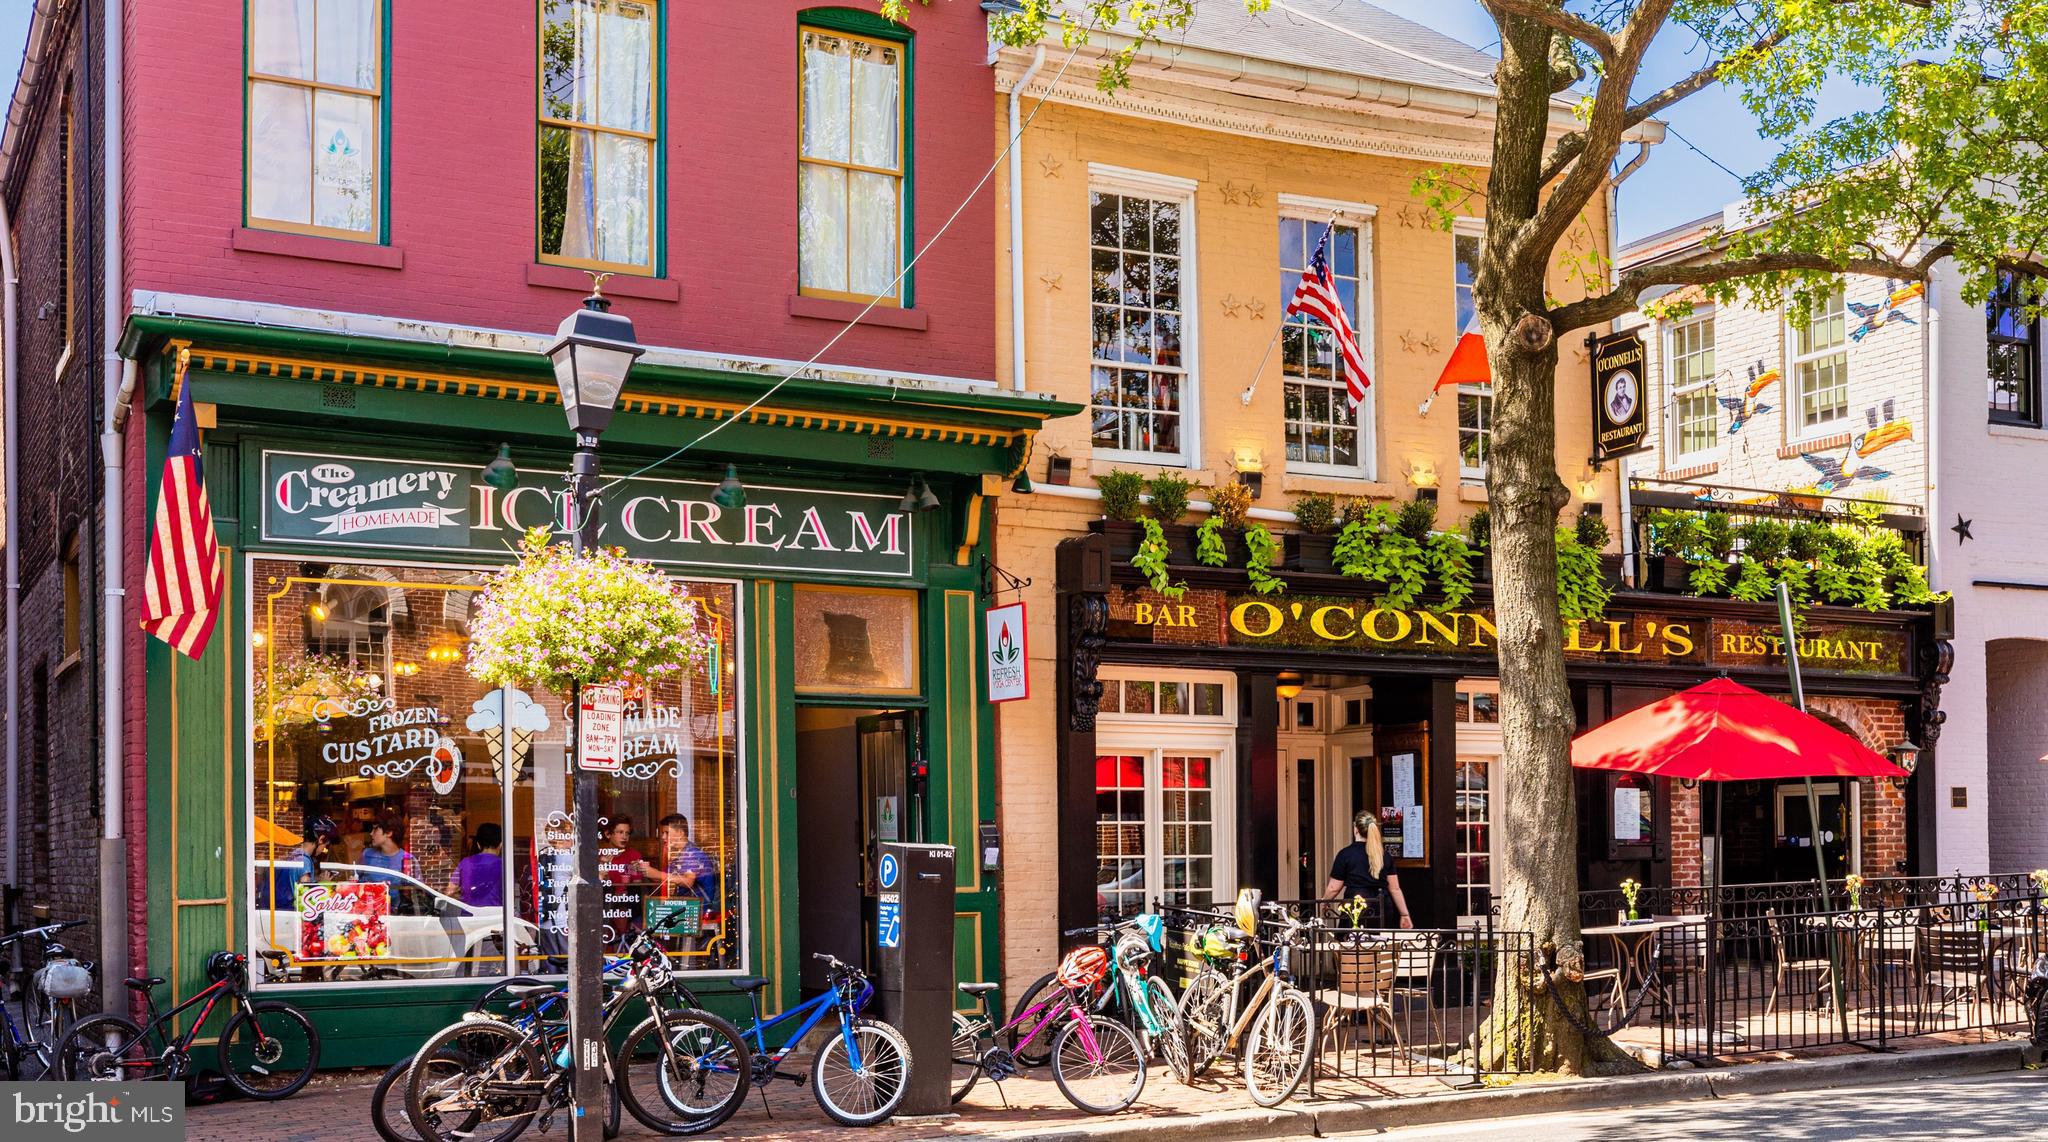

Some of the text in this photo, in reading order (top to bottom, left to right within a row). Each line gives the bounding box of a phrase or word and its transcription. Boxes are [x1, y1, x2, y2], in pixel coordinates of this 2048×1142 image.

[1598, 348, 1642, 372] O'CONNELL'S
[1601, 422, 1643, 442] RESTAURANT
[317, 467, 350, 478] The
[275, 468, 457, 514] Creamery
[342, 511, 436, 531] HOMEMADE
[621, 496, 905, 556] CREAM
[1134, 601, 1883, 661] BAR O'CONNLL'S RESTURANT
[992, 665, 1021, 681] REFRESH
[993, 678, 1022, 689] YOGA CENTER
[595, 693, 620, 706] ARKING
[368, 707, 440, 734] FROZEN
[586, 712, 616, 722] LOADING
[592, 723, 610, 732] ZONE
[322, 727, 440, 764] CUSTARD
[586, 734, 617, 744] 8AM-7PM
[622, 733, 682, 761] REAM
[588, 744, 614, 753] MON-SAT
[547, 862, 573, 872] Indo
[884, 860, 893, 882] P
[303, 887, 357, 919] Sorbet
[547, 892, 640, 904] Dai Sorbet
[547, 910, 563, 920] No
